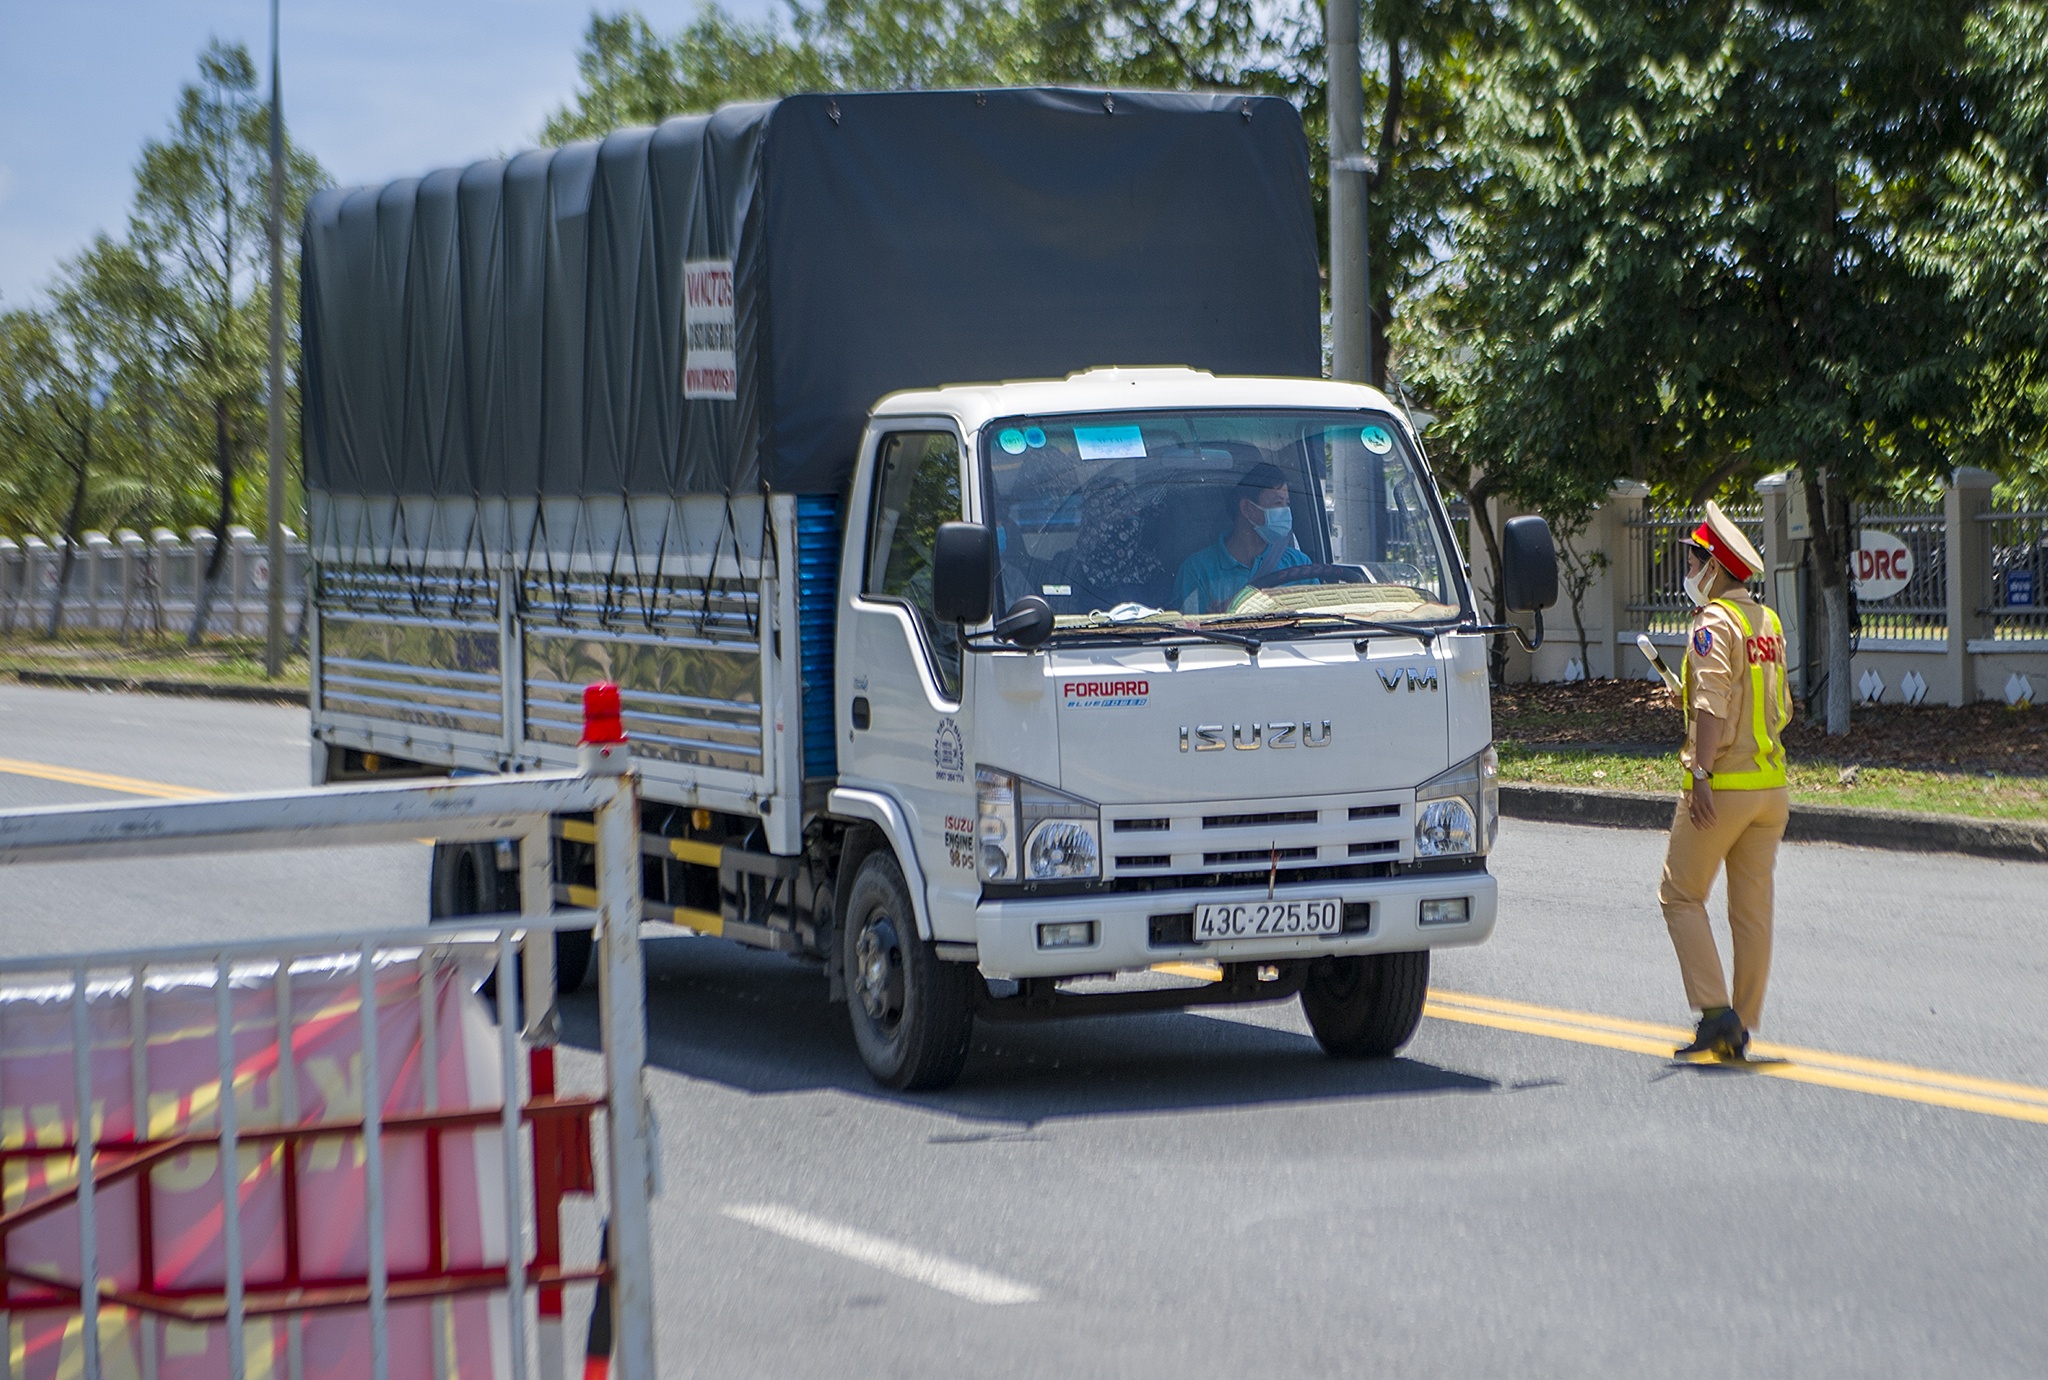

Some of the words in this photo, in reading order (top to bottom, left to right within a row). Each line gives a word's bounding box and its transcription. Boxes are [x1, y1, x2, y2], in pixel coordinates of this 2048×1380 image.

[1858, 549, 1907, 580] DRC
[1064, 681, 1149, 698] FORWARD
[1376, 667, 1438, 693] VM
[1179, 720, 1332, 753] ISUZU
[945, 815, 974, 832] ISUZU
[945, 832, 973, 851] ENGINE
[1200, 902, 1336, 937] 43C-225.50
